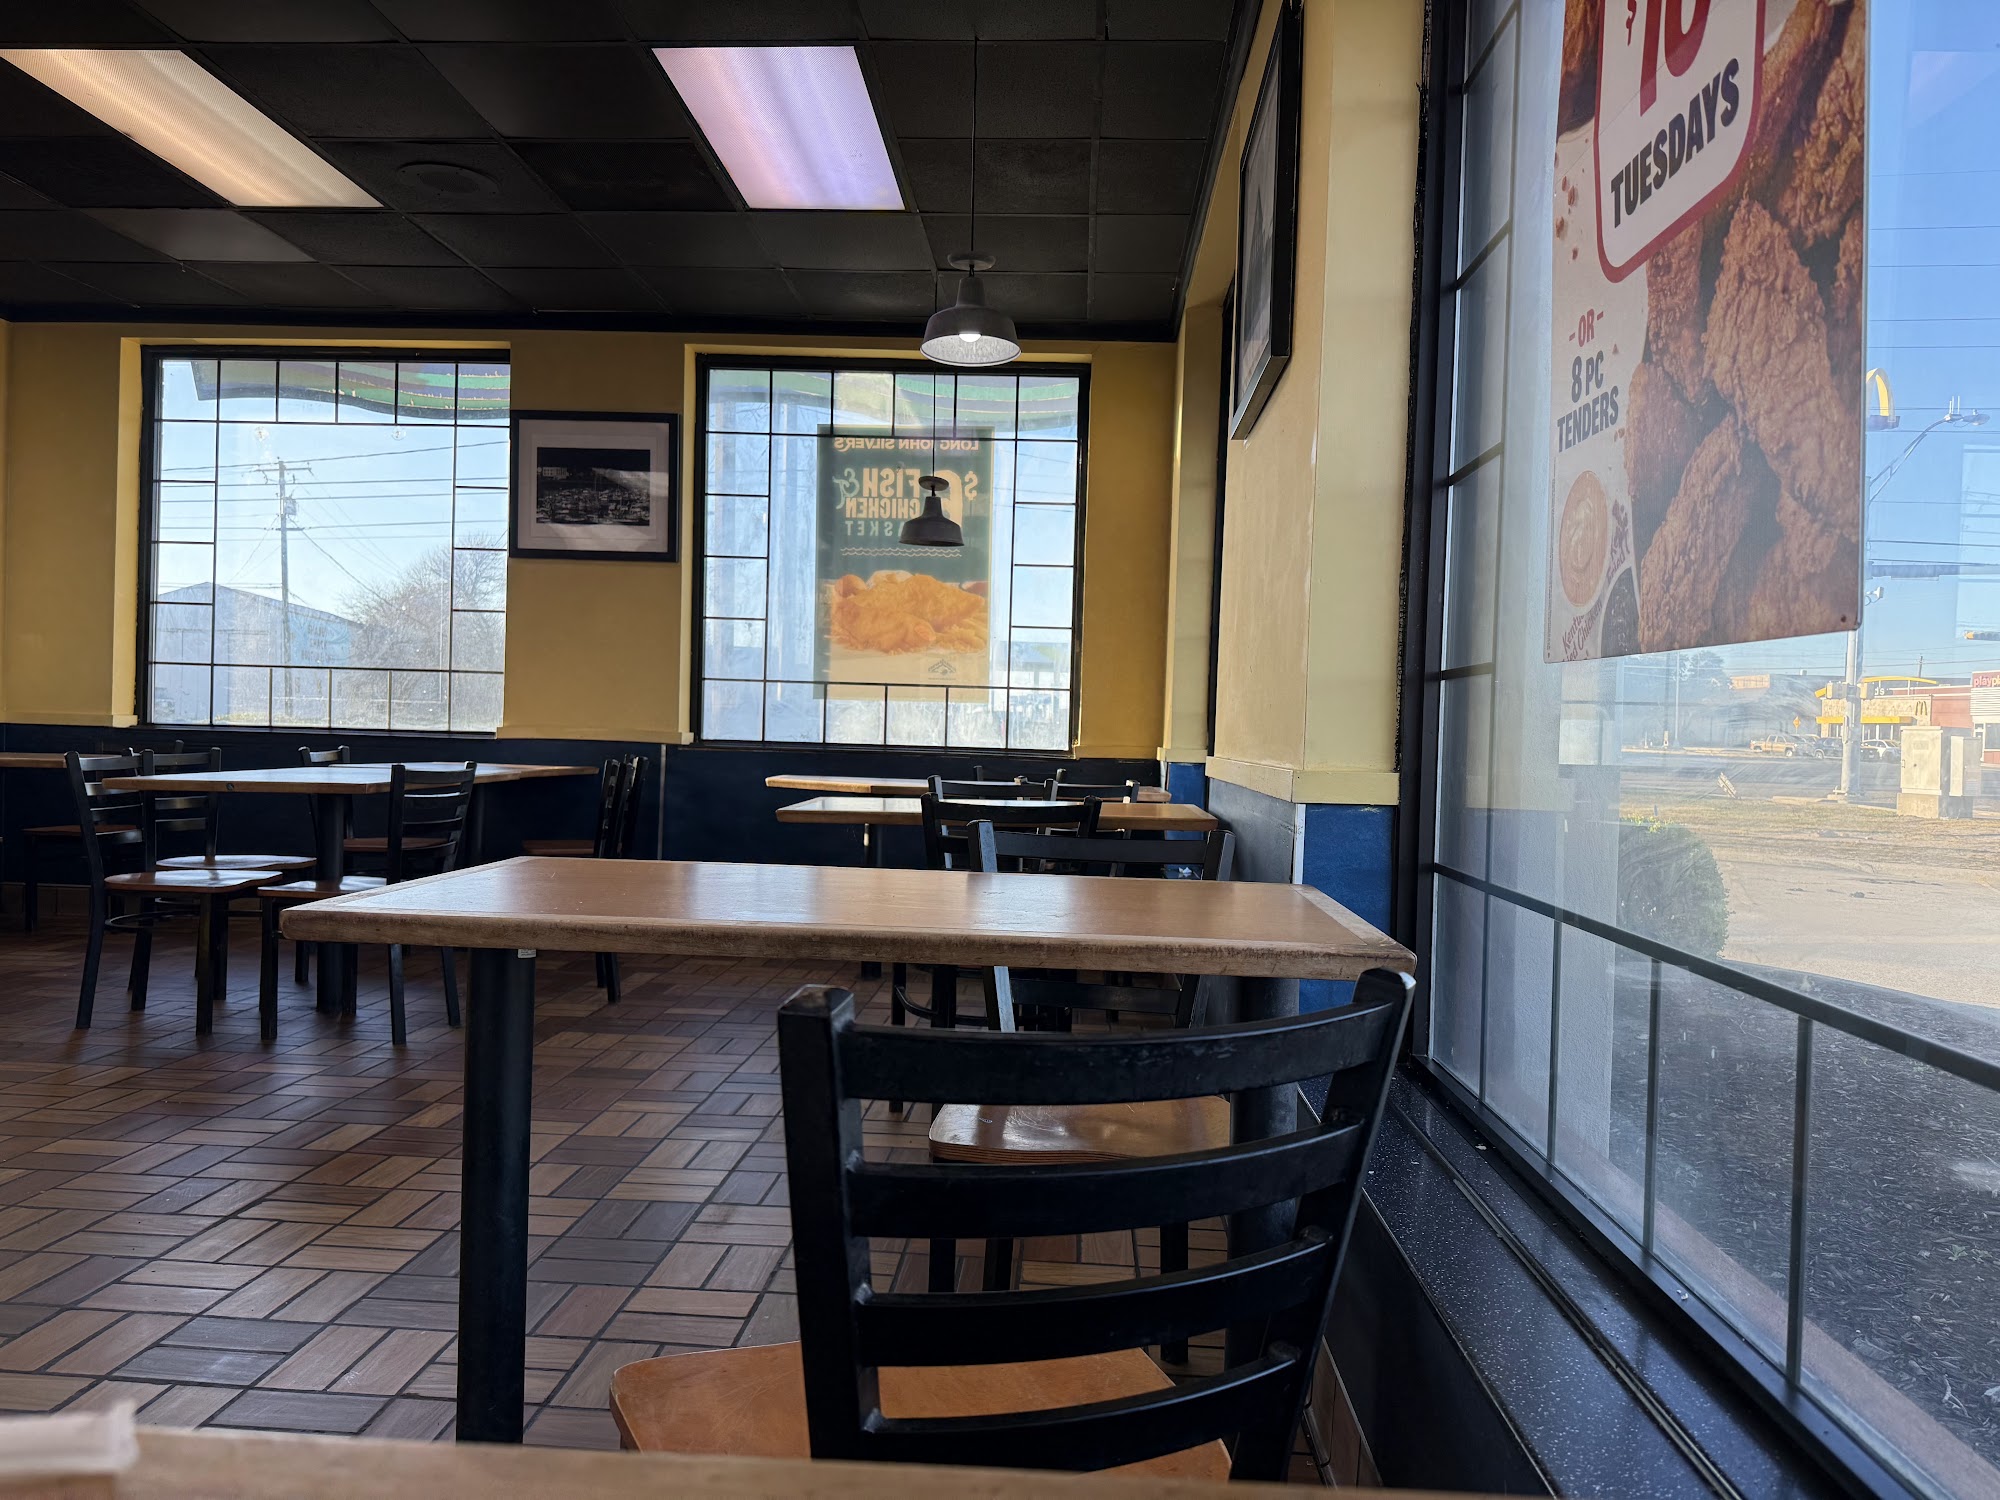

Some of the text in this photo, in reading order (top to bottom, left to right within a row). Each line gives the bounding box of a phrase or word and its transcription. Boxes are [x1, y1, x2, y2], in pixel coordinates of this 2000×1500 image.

[1611, 58, 1739, 229] TUESDAYS
[1571, 350, 1604, 403] 8 PC
[1557, 385, 1619, 453] TENDERS
